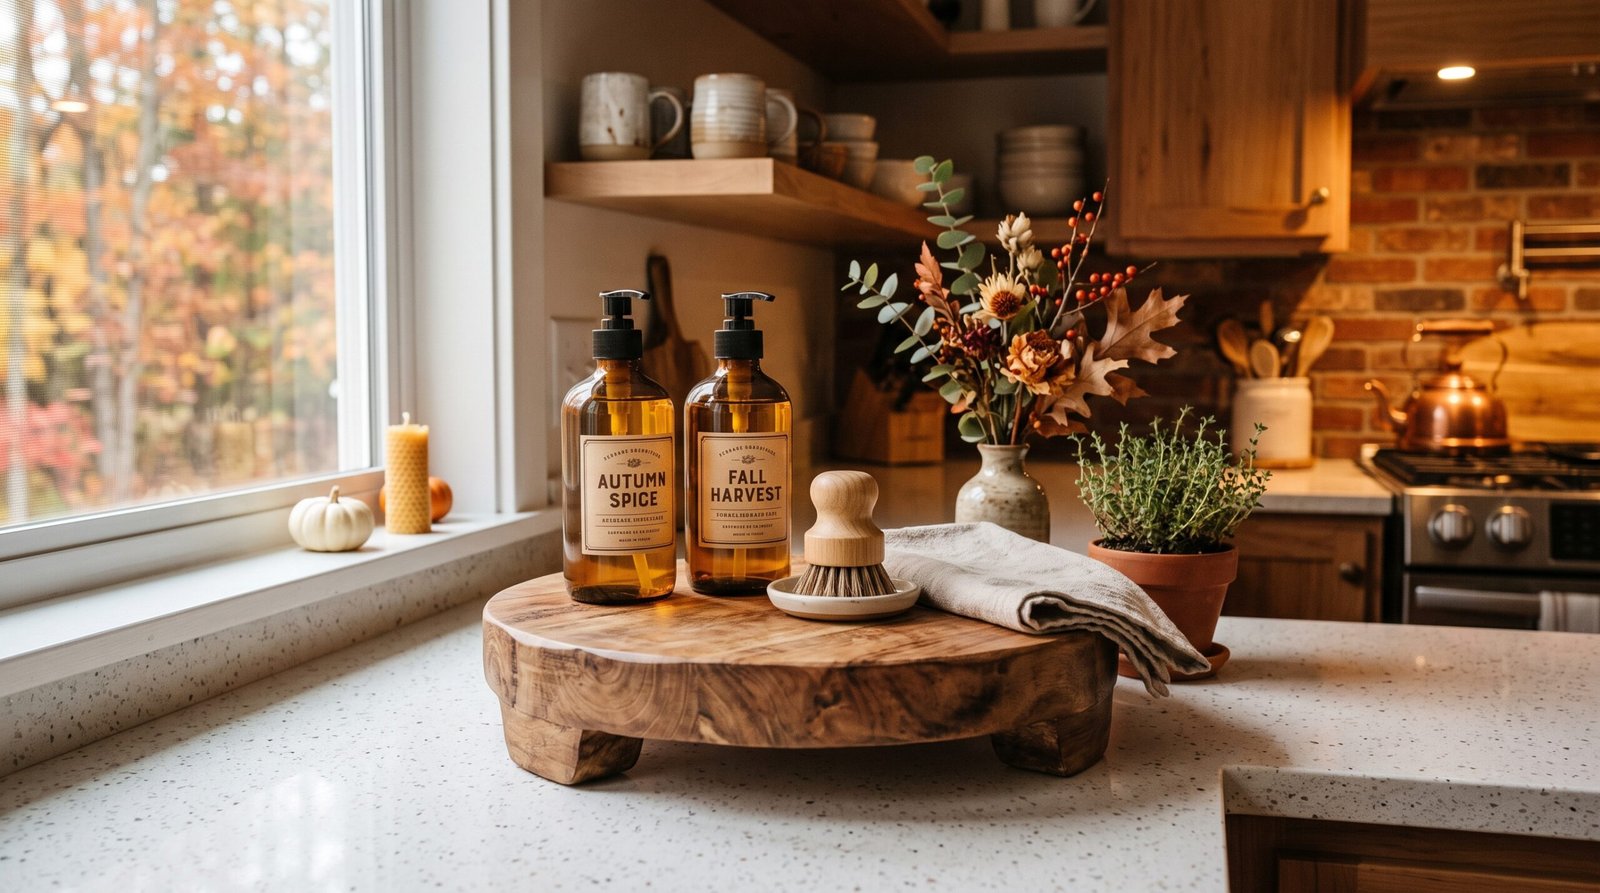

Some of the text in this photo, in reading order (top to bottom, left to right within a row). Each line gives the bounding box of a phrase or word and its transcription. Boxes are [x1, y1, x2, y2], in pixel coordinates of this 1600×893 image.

[598, 471, 666, 489] AUTUMN
[729, 469, 767, 485] FALL
[609, 491, 658, 508] SPICE
[711, 486, 782, 502] HARVEST
